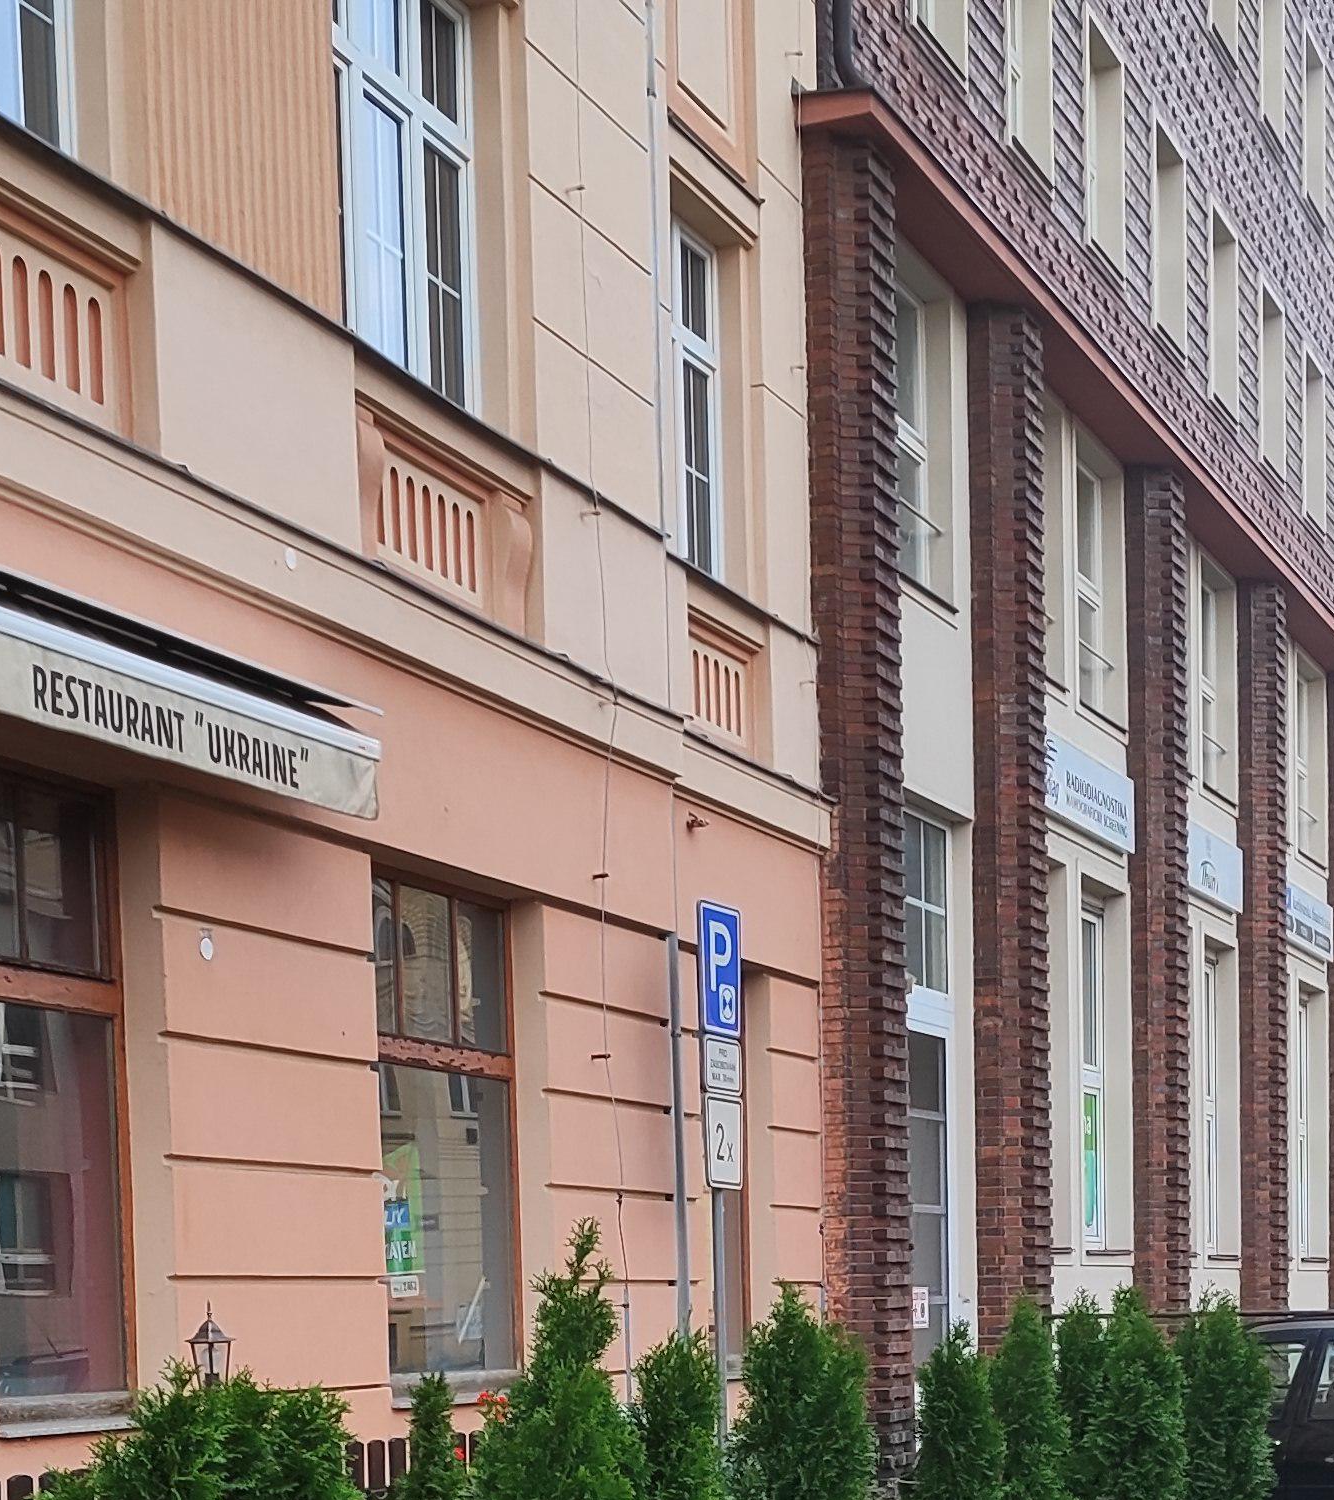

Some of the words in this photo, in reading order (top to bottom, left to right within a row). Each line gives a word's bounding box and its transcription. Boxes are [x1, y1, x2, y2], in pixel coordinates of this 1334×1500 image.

[32, 664, 184, 752] RESTAURANT
[194, 711, 309, 789] "UKRAINE"
[709, 920, 731, 991] P
